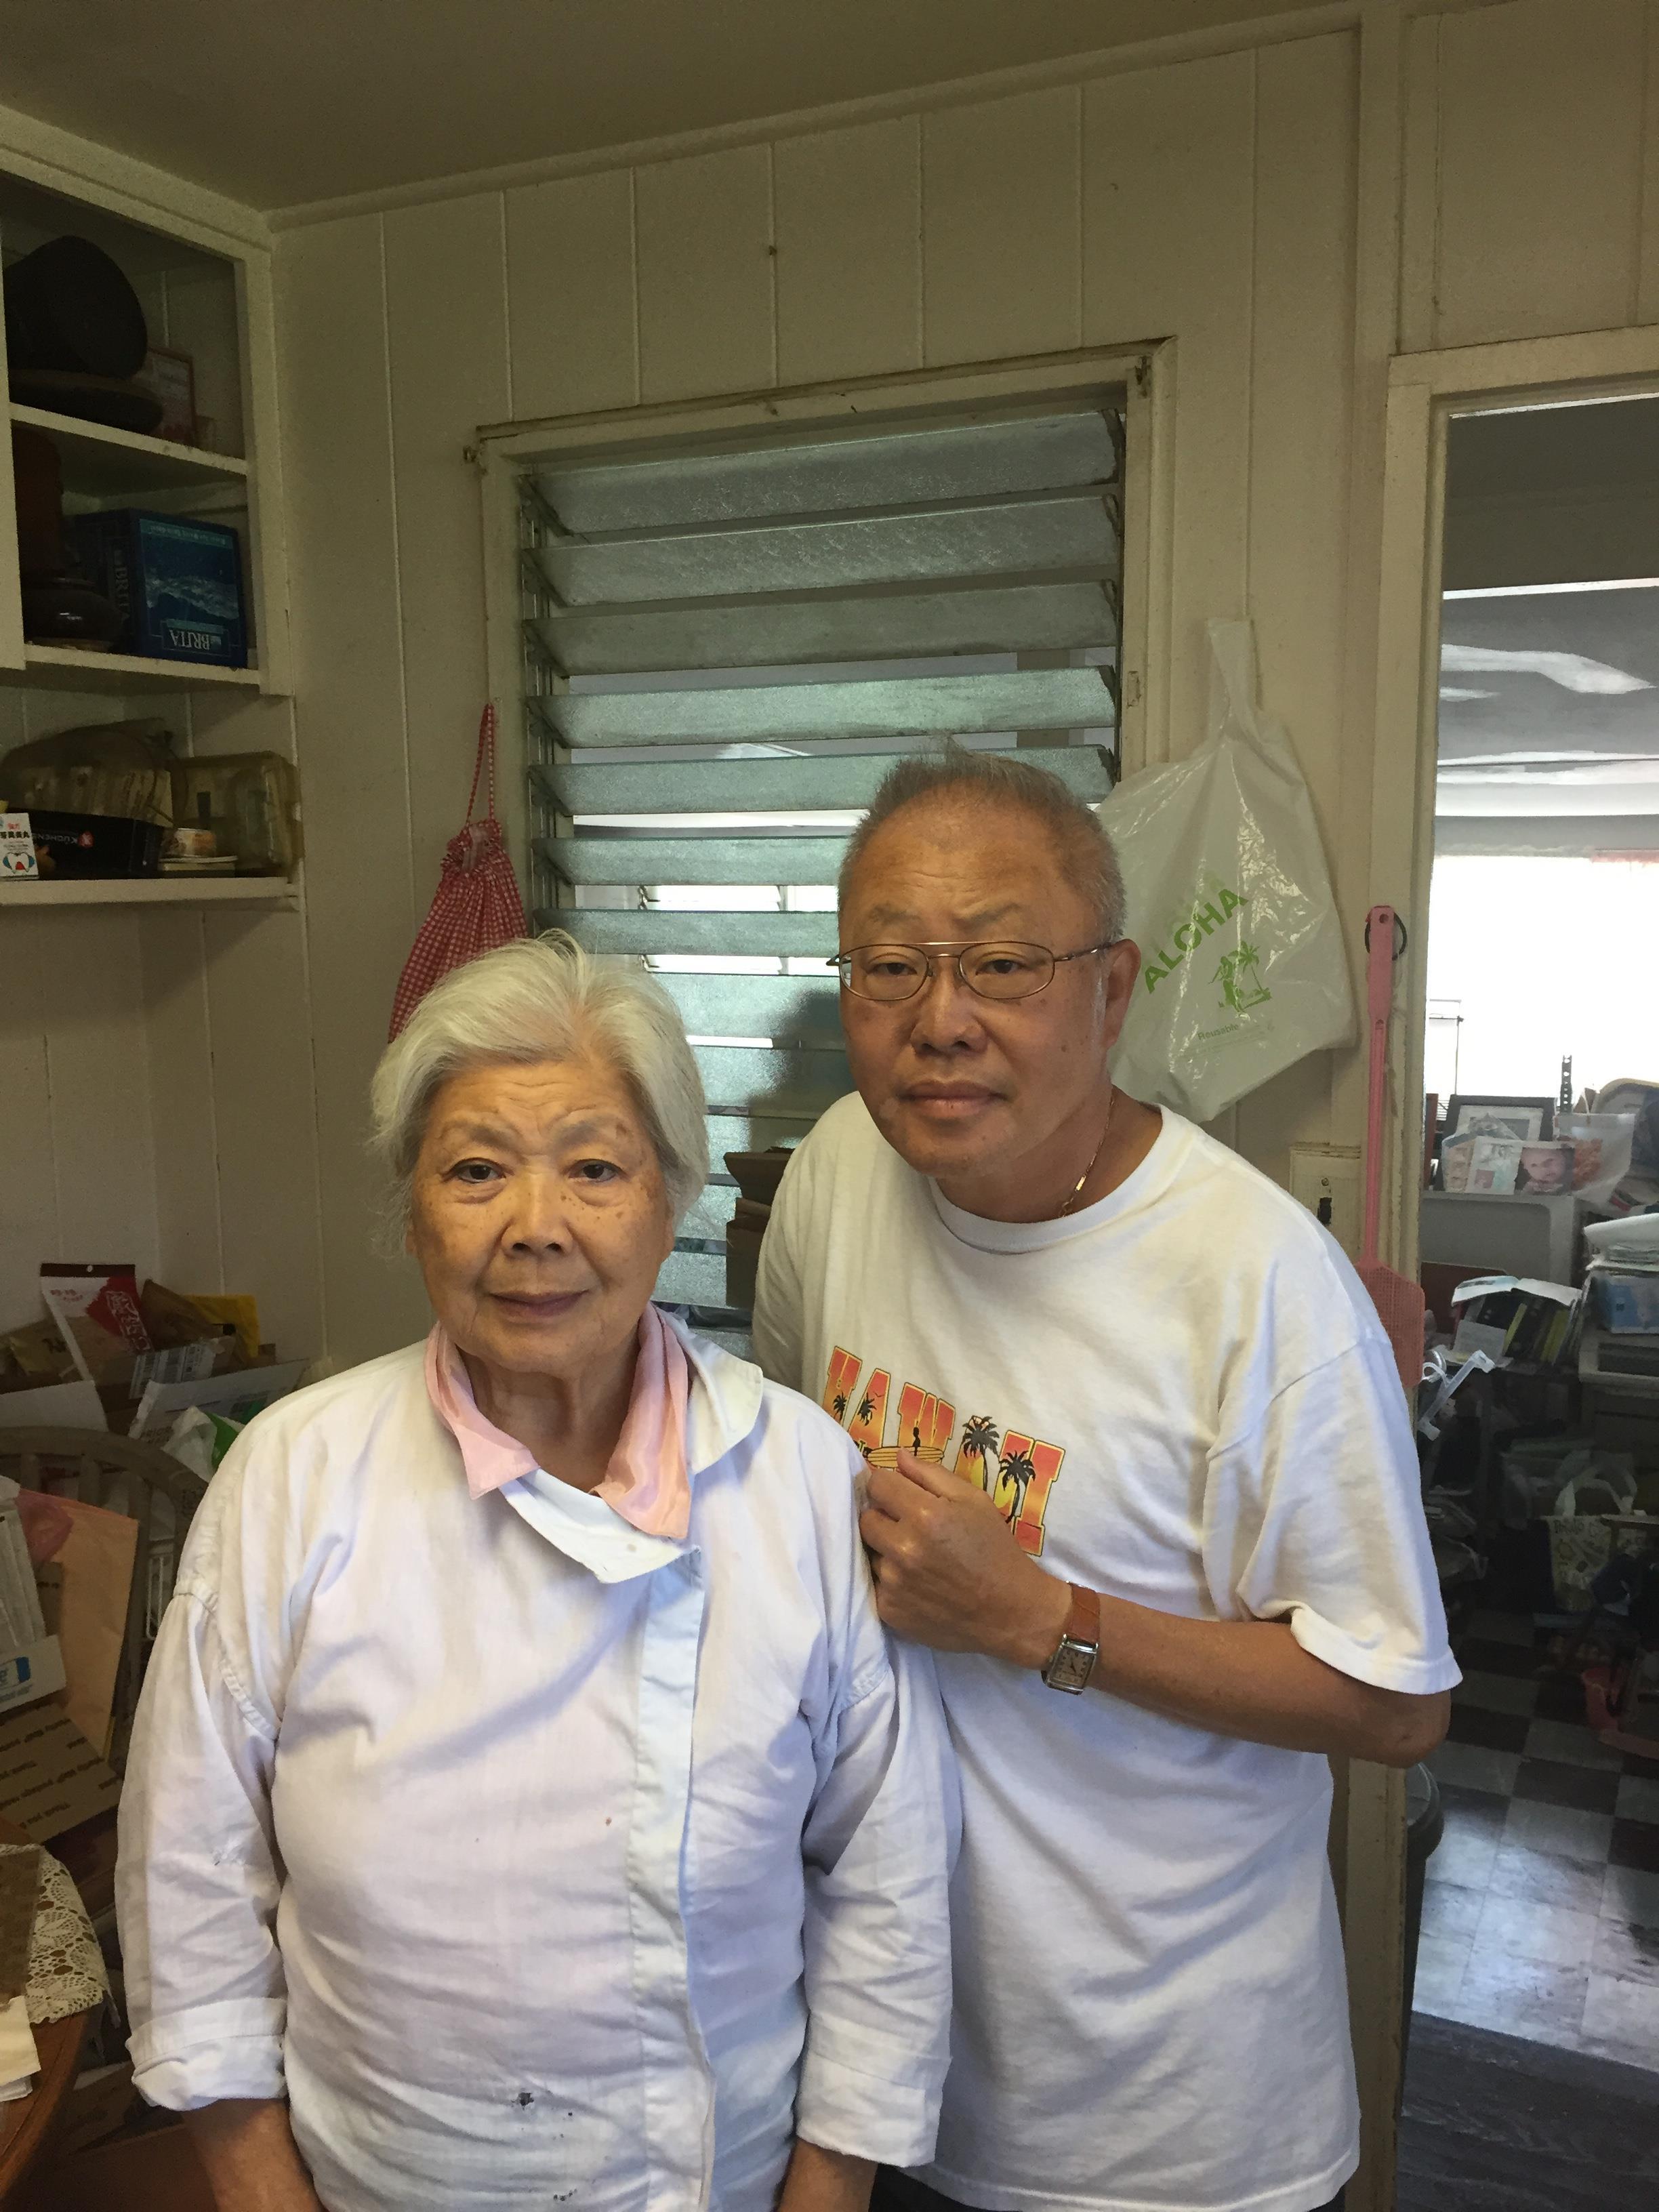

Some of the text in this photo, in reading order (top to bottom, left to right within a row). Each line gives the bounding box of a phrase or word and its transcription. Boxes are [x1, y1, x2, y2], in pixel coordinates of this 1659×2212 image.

[169, 629, 211, 651] BRITA
[1143, 886, 1248, 994] ALOHA
[1197, 1023, 1240, 1040] Reusable
